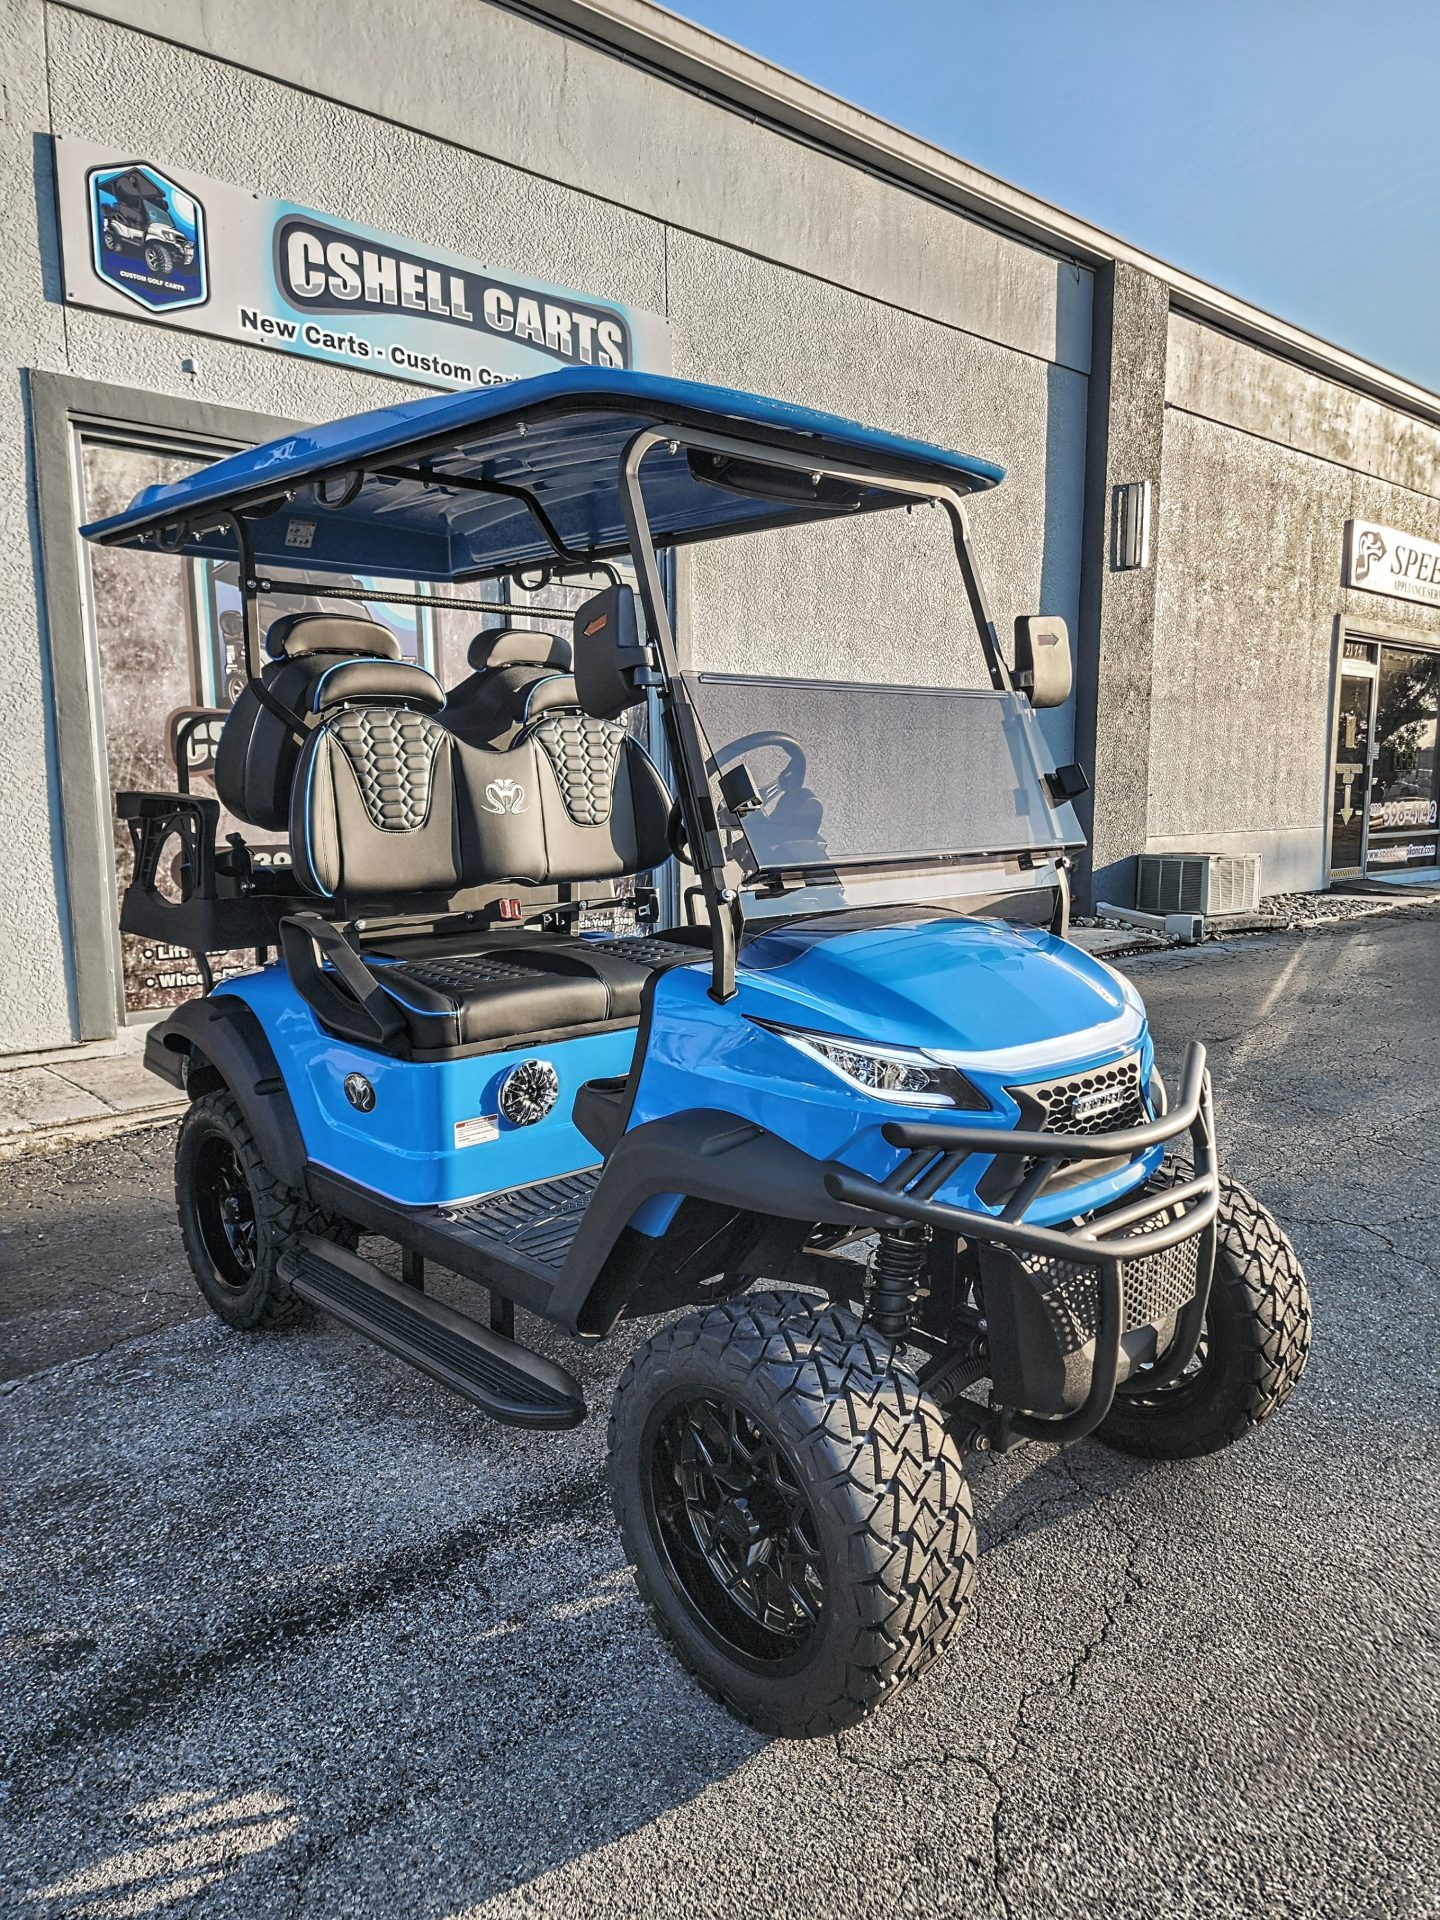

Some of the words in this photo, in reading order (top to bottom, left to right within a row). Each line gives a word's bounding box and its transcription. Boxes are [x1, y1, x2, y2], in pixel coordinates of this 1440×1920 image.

[119, 270, 147, 282] CUSTOM
[147, 277, 164, 286] GOLF
[164, 281, 186, 292] CARTS
[287, 230, 474, 323] CSHELL
[483, 288, 623, 370] CARTS
[240, 308, 297, 340] New
[304, 325, 370, 358] Carts
[390, 346, 472, 383] Custom
[592, 918, 613, 927] Your
[613, 916, 634, 927] Step
[157, 945, 189, 960] Lift
